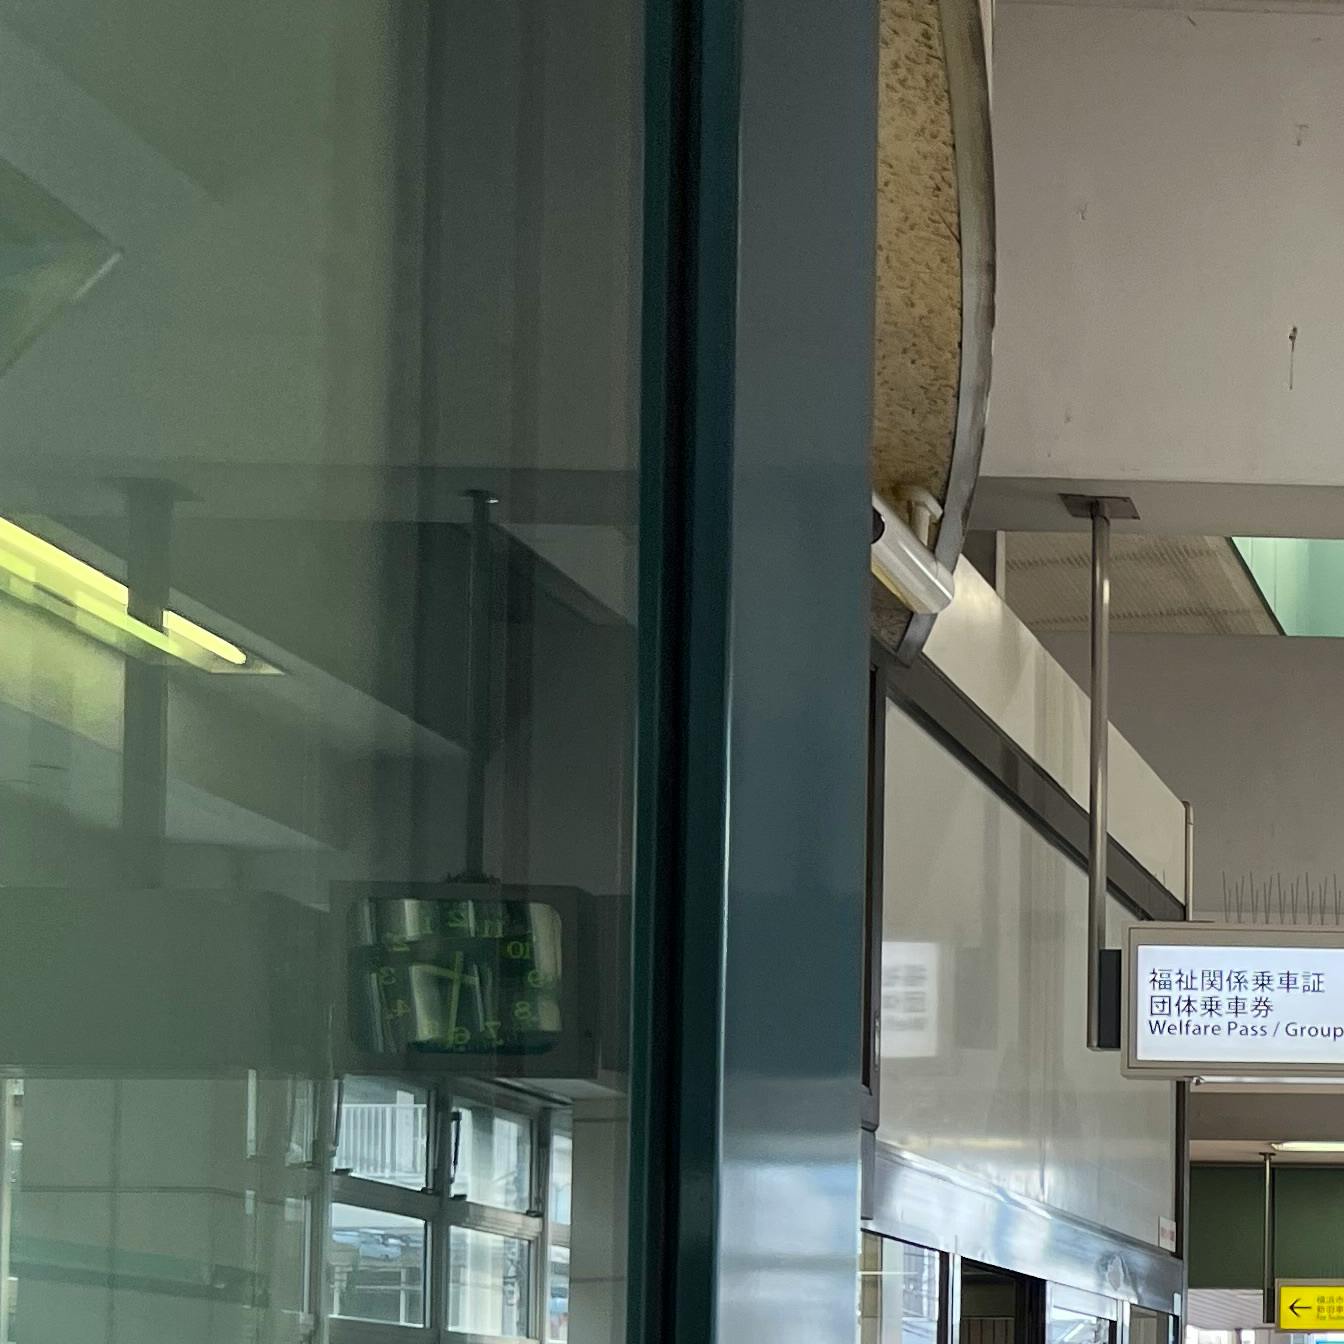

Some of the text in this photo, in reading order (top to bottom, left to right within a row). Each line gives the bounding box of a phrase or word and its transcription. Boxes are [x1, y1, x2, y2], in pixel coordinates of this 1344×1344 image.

[1149, 968, 1326, 994] 福祉関係乗車証
[1149, 995, 1274, 1018] 団体乗車券
[1148, 1020, 1222, 1037] Welfare
[1228, 1022, 1268, 1038] Pass
[1273, 1021, 1281, 1039] /
[1285, 1023, 1344, 1042] Group
